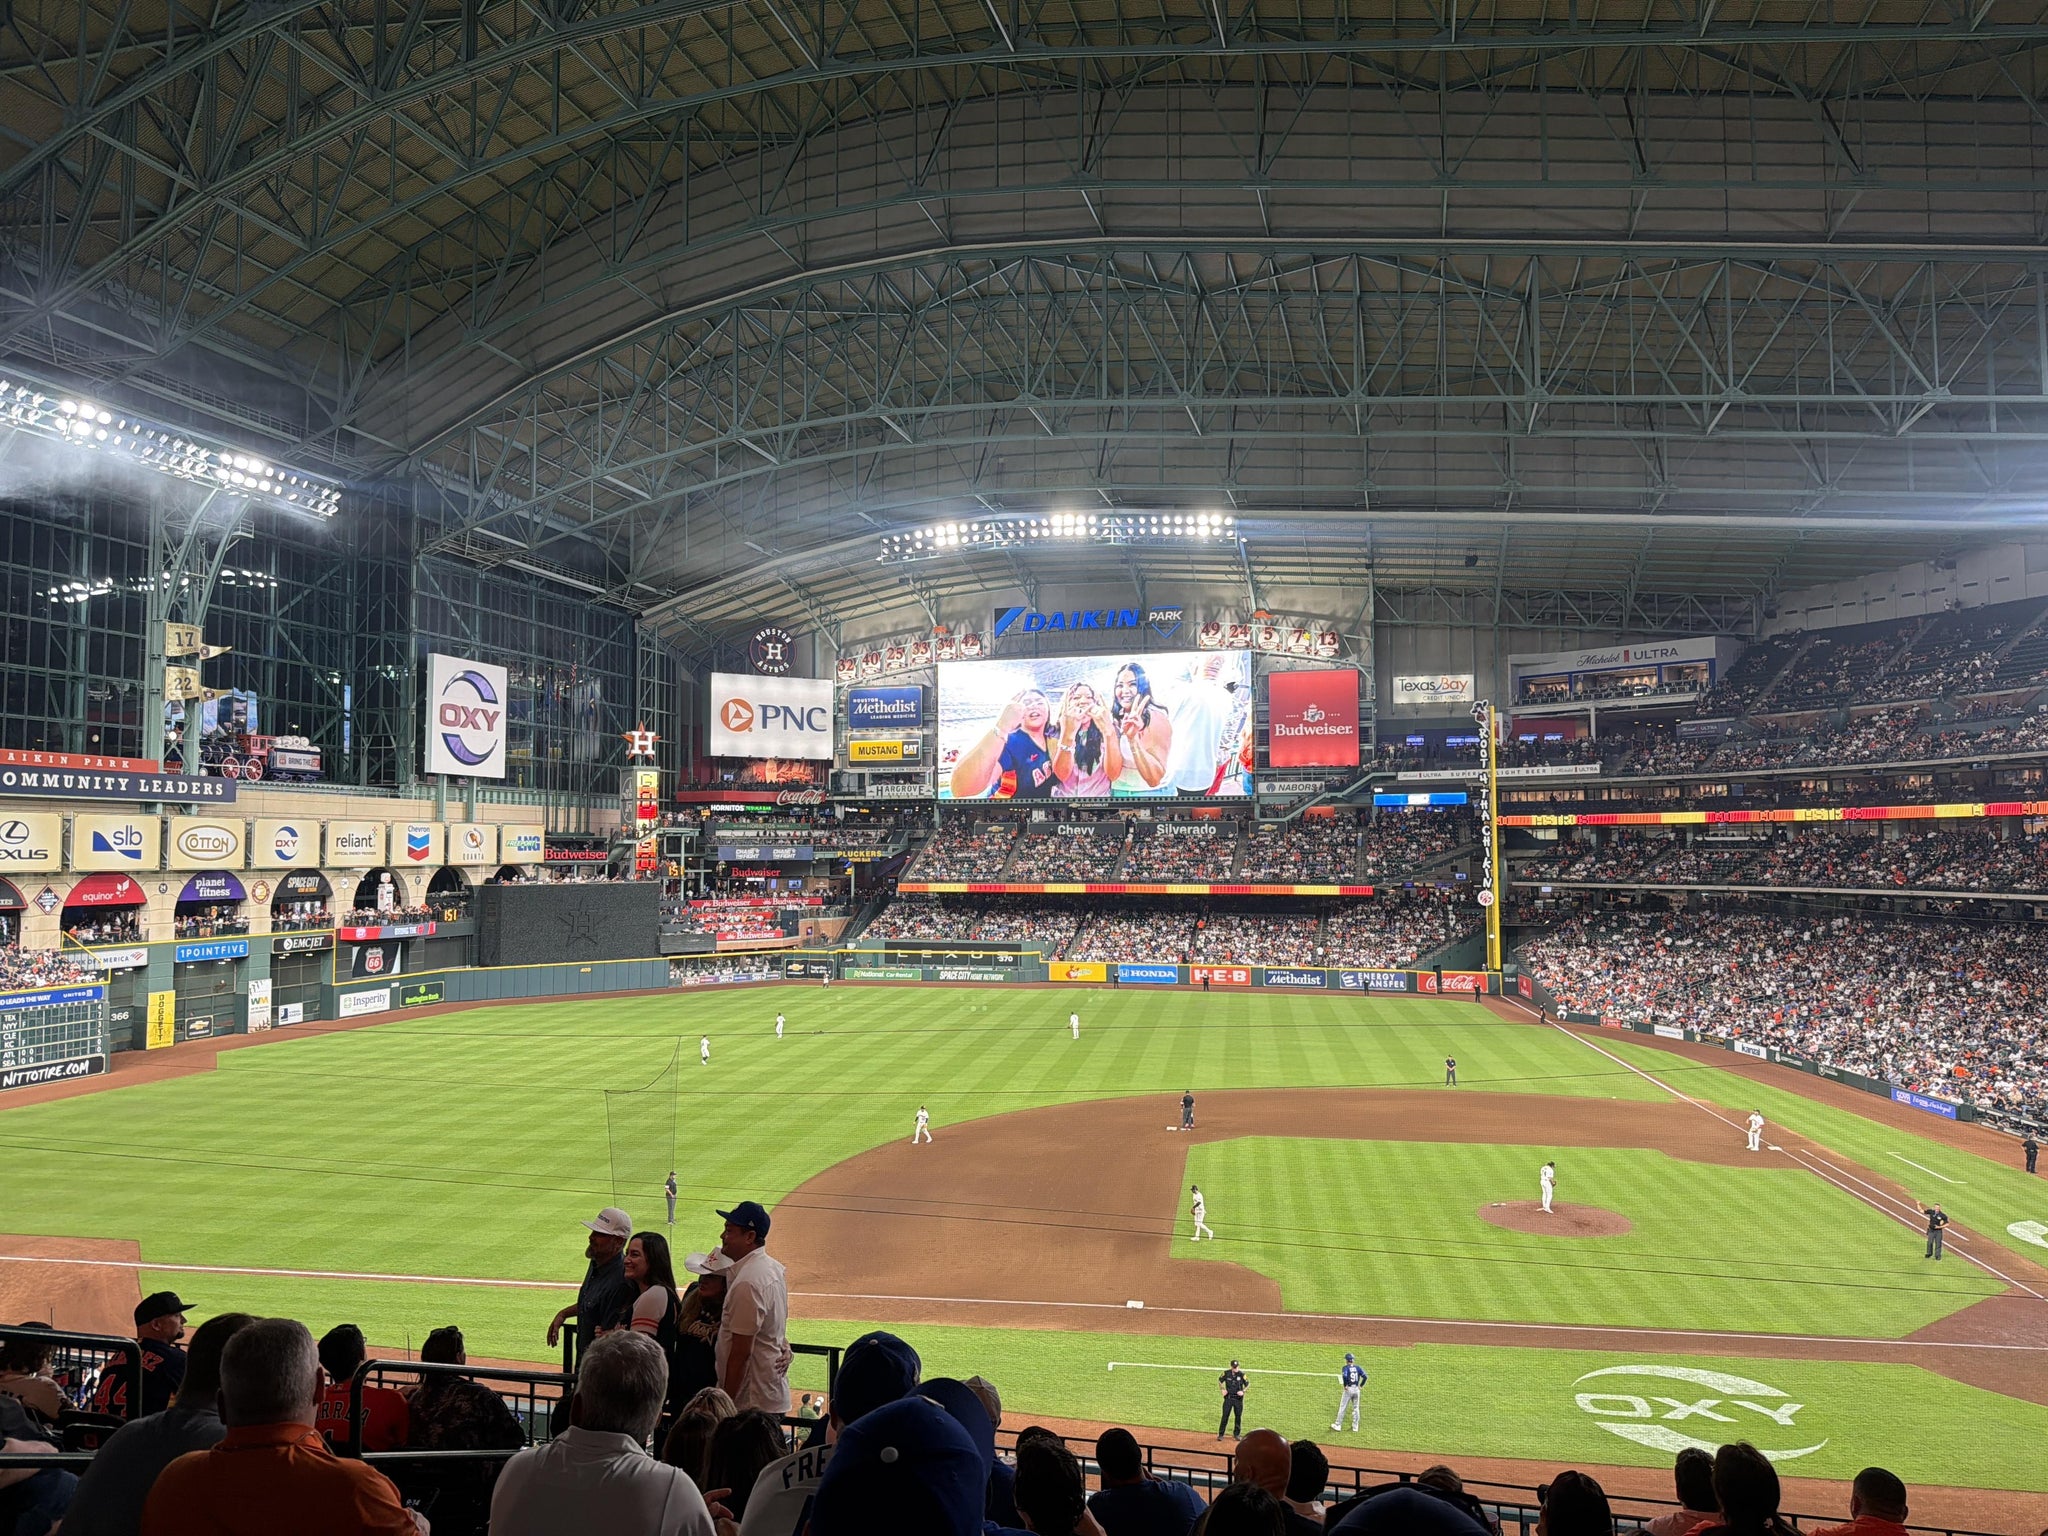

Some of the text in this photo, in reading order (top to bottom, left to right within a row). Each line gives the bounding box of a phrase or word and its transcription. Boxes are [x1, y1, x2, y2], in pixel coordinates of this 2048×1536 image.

[1023, 608, 1183, 632] DAIKIN PARK
[1201, 622, 1220, 636] 49
[1229, 624, 1249, 637] 24
[1264, 628, 1273, 640] 5
[175, 632, 194, 647] 17
[756, 628, 791, 644] HOUSTON
[961, 633, 978, 646] 42
[1294, 630, 1303, 643] 7
[1318, 632, 1337, 646] 13
[913, 642, 929, 654] 33
[937, 638, 954, 650] 34
[766, 643, 782, 659] H
[887, 647, 903, 660] 25
[1576, 647, 1679, 667] Michelob ULTRA
[838, 658, 854, 672] 32
[862, 653, 878, 666] 40
[757, 661, 789, 673] ASTROS
[174, 677, 192, 690] 22
[1399, 677, 1468, 693] Texas Bay
[853, 700, 916, 714] Methodist
[439, 702, 500, 732] OXY
[758, 703, 827, 732] PNC
[632, 731, 655, 754] H
[1478, 727, 1489, 769] ROOT
[858, 744, 918, 755] MUSTANG CAT
[8, 752, 130, 769] AIKIN PARK
[2, 771, 224, 796] OMMUNITY LEADERS
[1478, 772, 1489, 785] 4
[876, 785, 925, 797] HARGROVE
[1279, 783, 1317, 792] NABORS
[777, 789, 825, 806] Coca-Cola
[1480, 787, 1492, 822] THA
[113, 825, 142, 846] slb
[408, 825, 430, 833] Chevron
[1058, 823, 1216, 836] Chevy Silverado
[185, 834, 229, 854] COTTON
[275, 839, 298, 848] OXY
[336, 833, 373, 848] reliant
[506, 836, 540, 851] FREEPORT LNG
[0, 849, 48, 860] XUS
[463, 852, 484, 861] QUANTA
[545, 849, 608, 860] Budweiser
[731, 867, 781, 877] Budweiser
[195, 877, 225, 889] planet
[288, 877, 320, 888] SPACE CITY
[82, 892, 114, 902] equinor
[199, 887, 231, 897] fitness
[712, 899, 751, 907] Budweiser
[736, 932, 775, 940] Budweiser
[293, 937, 324, 949] EMCJET
[181, 945, 244, 958] 1POINTFIVE
[368, 957, 380, 968] 66
[860, 970, 884, 978] National
[940, 970, 959, 980] SPACE
[958, 970, 971, 980] CITY
[1131, 970, 1176, 978] HONDA
[1268, 972, 1322, 985] Methodist
[1358, 973, 1395, 981] ENERGY
[1358, 980, 1404, 988] TANSFER
[6, 996, 25, 1004] LEADS
[250, 996, 269, 1005] WM
[353, 993, 386, 1007] Insperity
[111, 1012, 129, 1021] 366
[3, 1022, 17, 1030] NYY
[3, 1032, 16, 1040] CLE
[2, 1059, 16, 1067] SEA
[3, 1060, 90, 1087] NITTOTIRE.COM
[1350, 1372, 1358, 1382] 91
[1574, 1393, 1805, 1425] OXY
